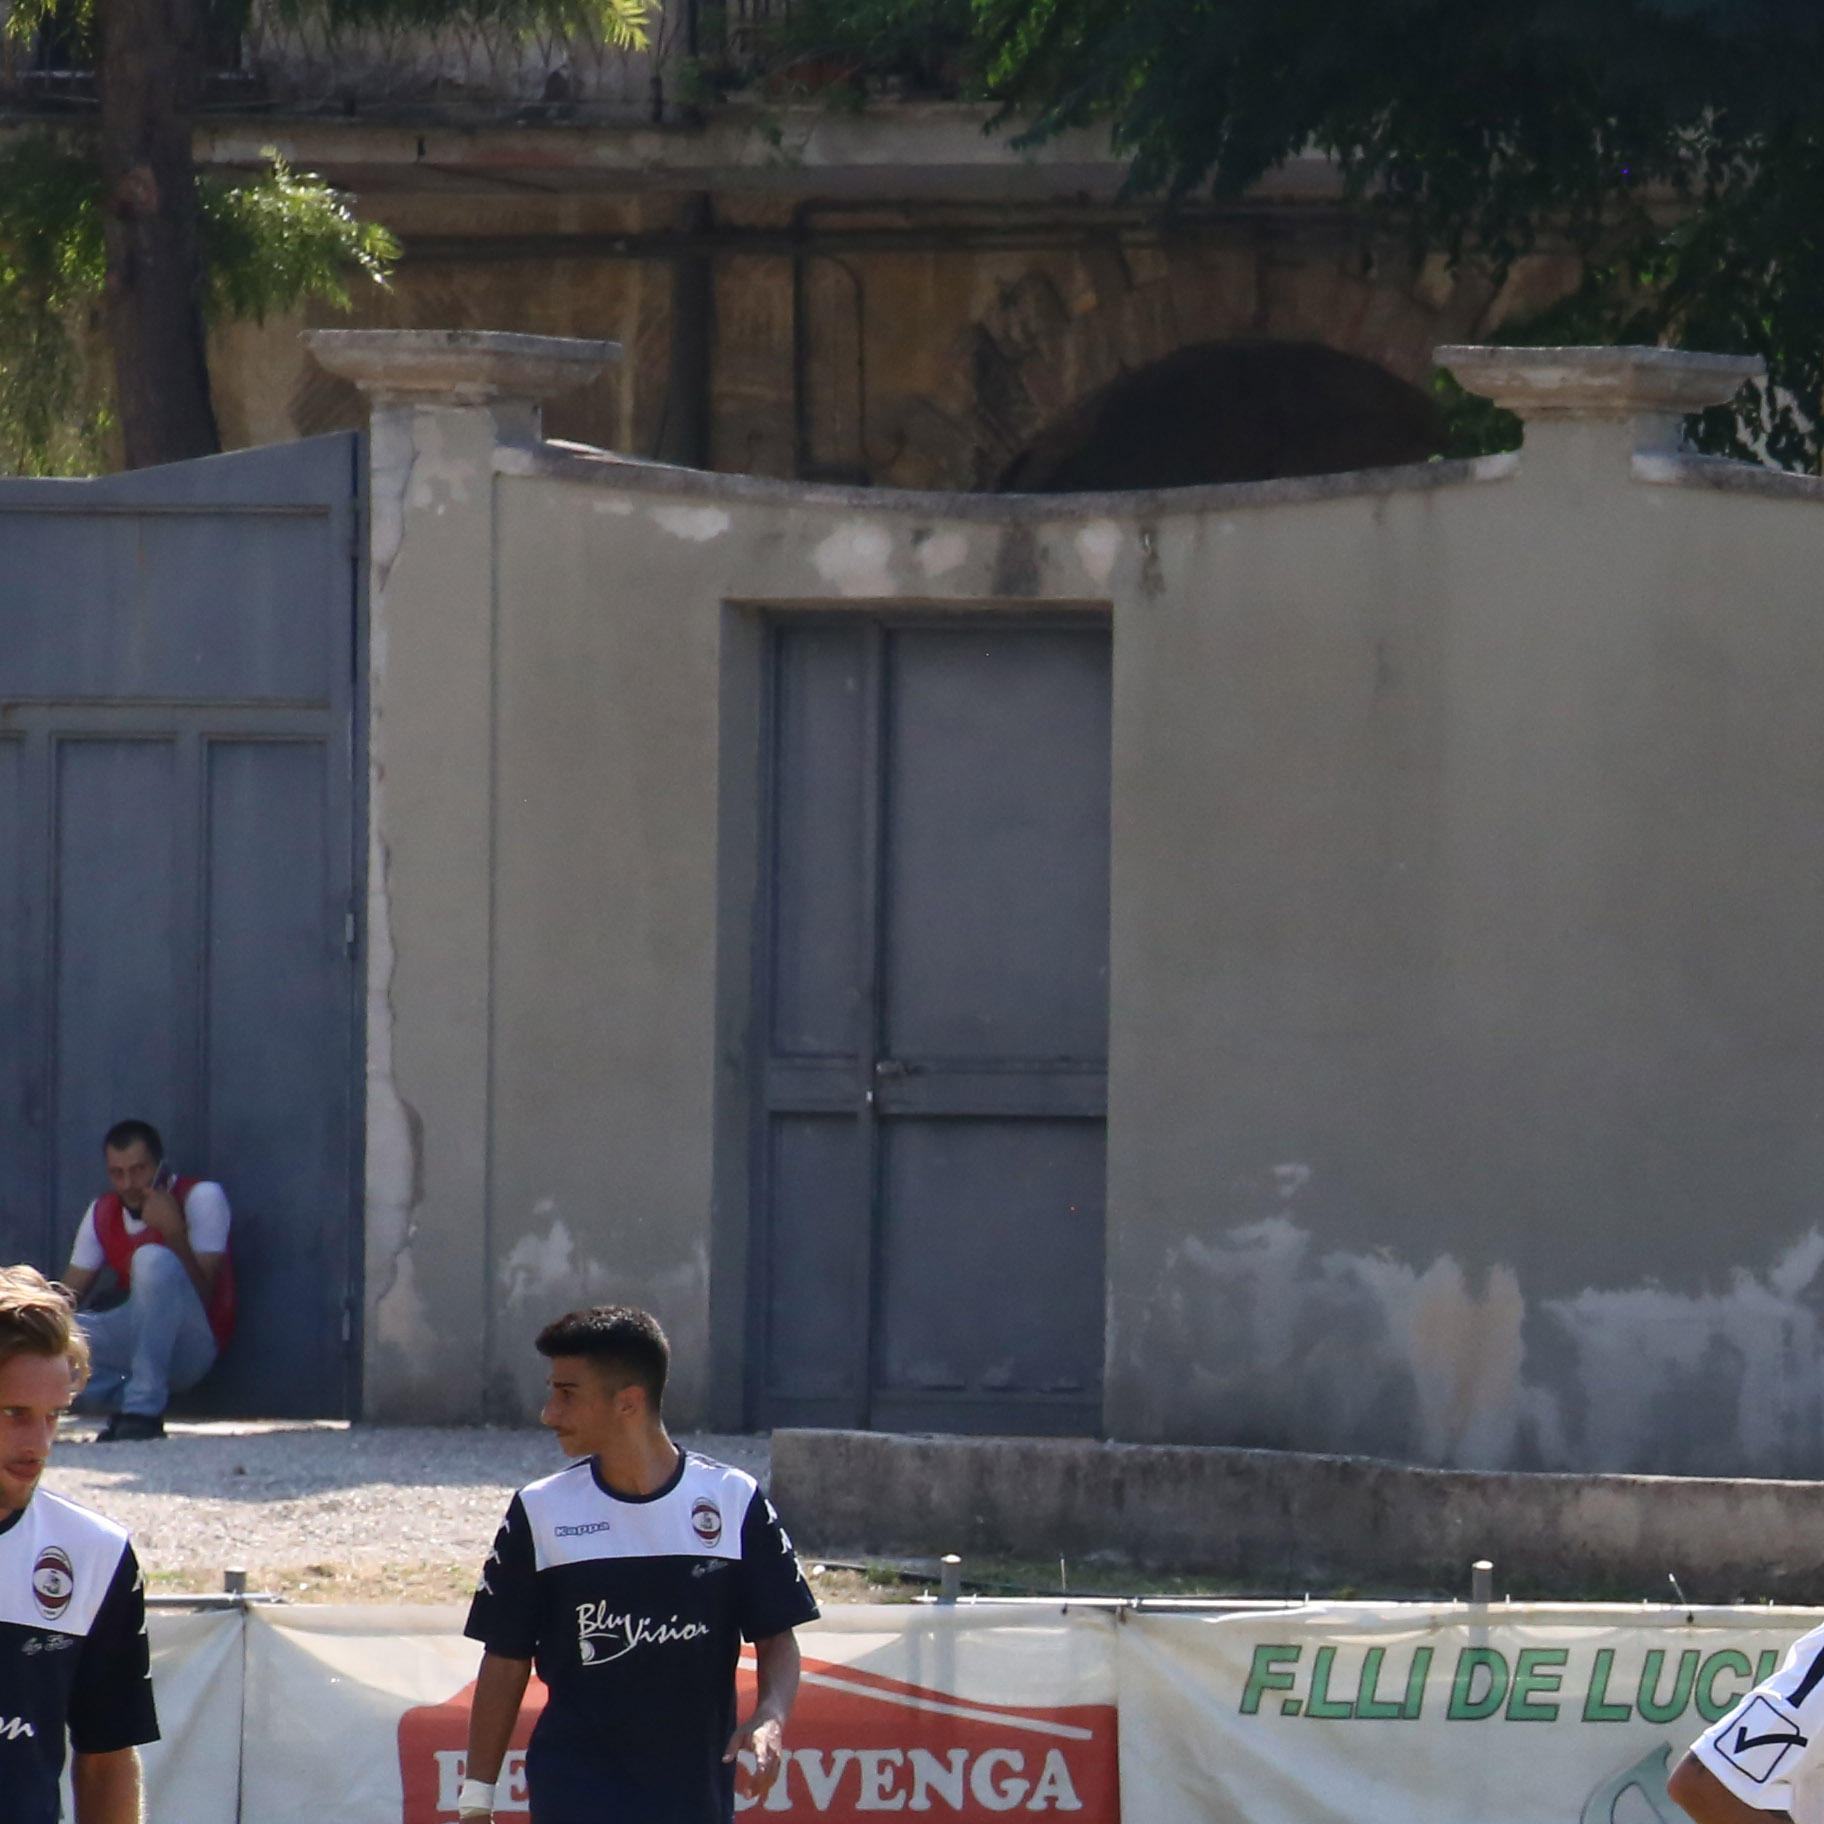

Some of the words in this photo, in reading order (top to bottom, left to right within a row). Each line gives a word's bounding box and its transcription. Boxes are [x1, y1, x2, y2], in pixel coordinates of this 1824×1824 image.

[555, 1522, 610, 1537] Kappa
[1238, 1644, 1435, 1721] F.LLI
[1445, 1646, 1570, 1722] DE
